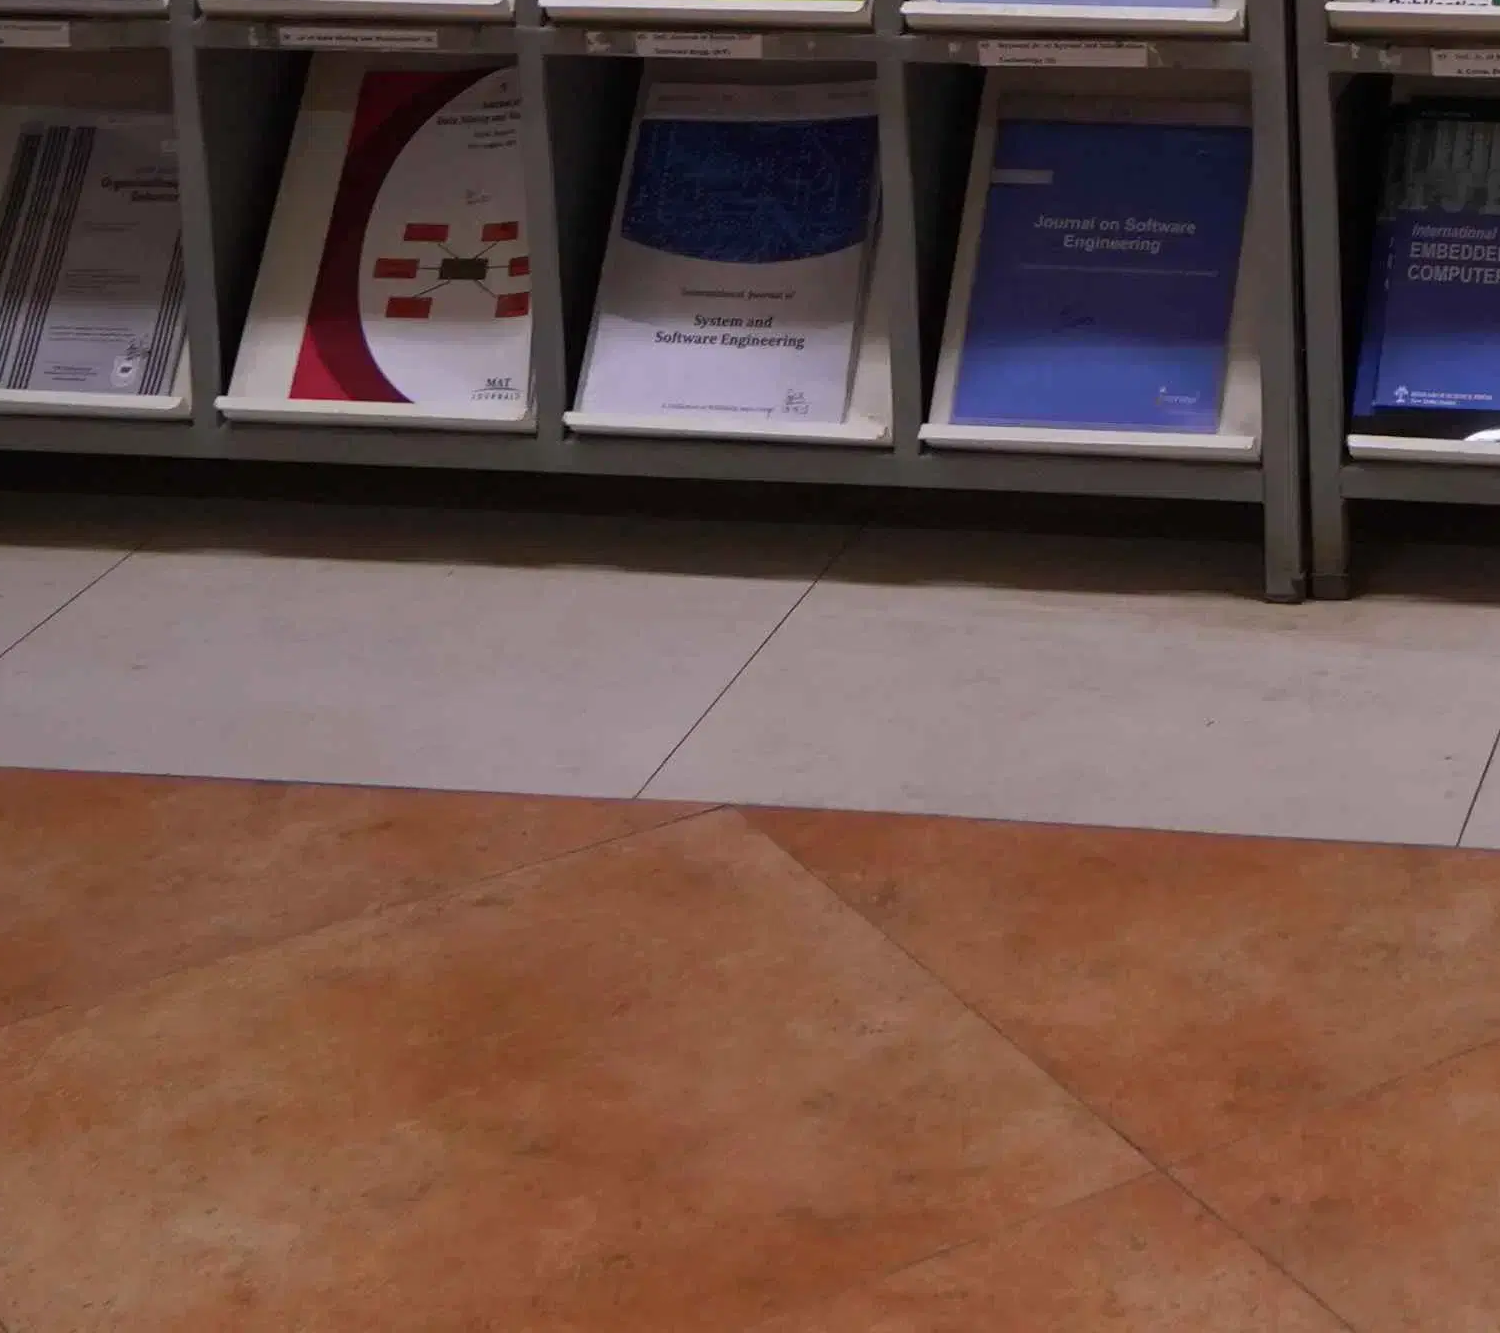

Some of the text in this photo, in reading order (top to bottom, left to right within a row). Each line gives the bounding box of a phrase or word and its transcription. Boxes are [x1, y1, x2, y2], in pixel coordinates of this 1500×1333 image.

[1032, 212, 1198, 237] Journal on Software
[1410, 223, 1498, 242] International
[1062, 233, 1163, 255] Engineering
[693, 313, 774, 331] System and
[653, 329, 807, 351] Software Engineering
